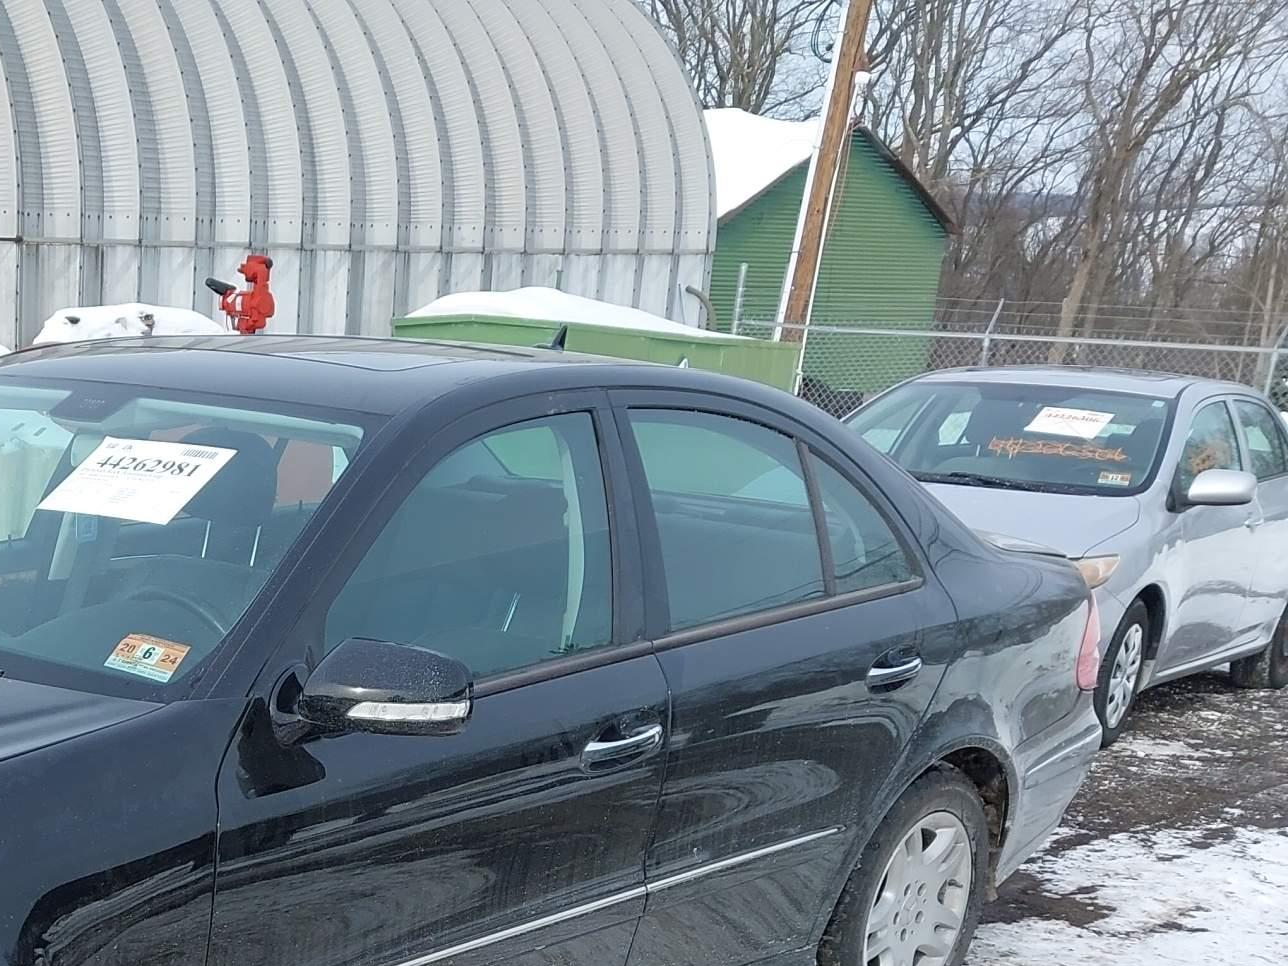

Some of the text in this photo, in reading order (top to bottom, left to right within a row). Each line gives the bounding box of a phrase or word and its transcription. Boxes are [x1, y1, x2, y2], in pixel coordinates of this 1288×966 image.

[96, 455, 203, 478] 44262981
[120, 643, 179, 665] 20 6 24
